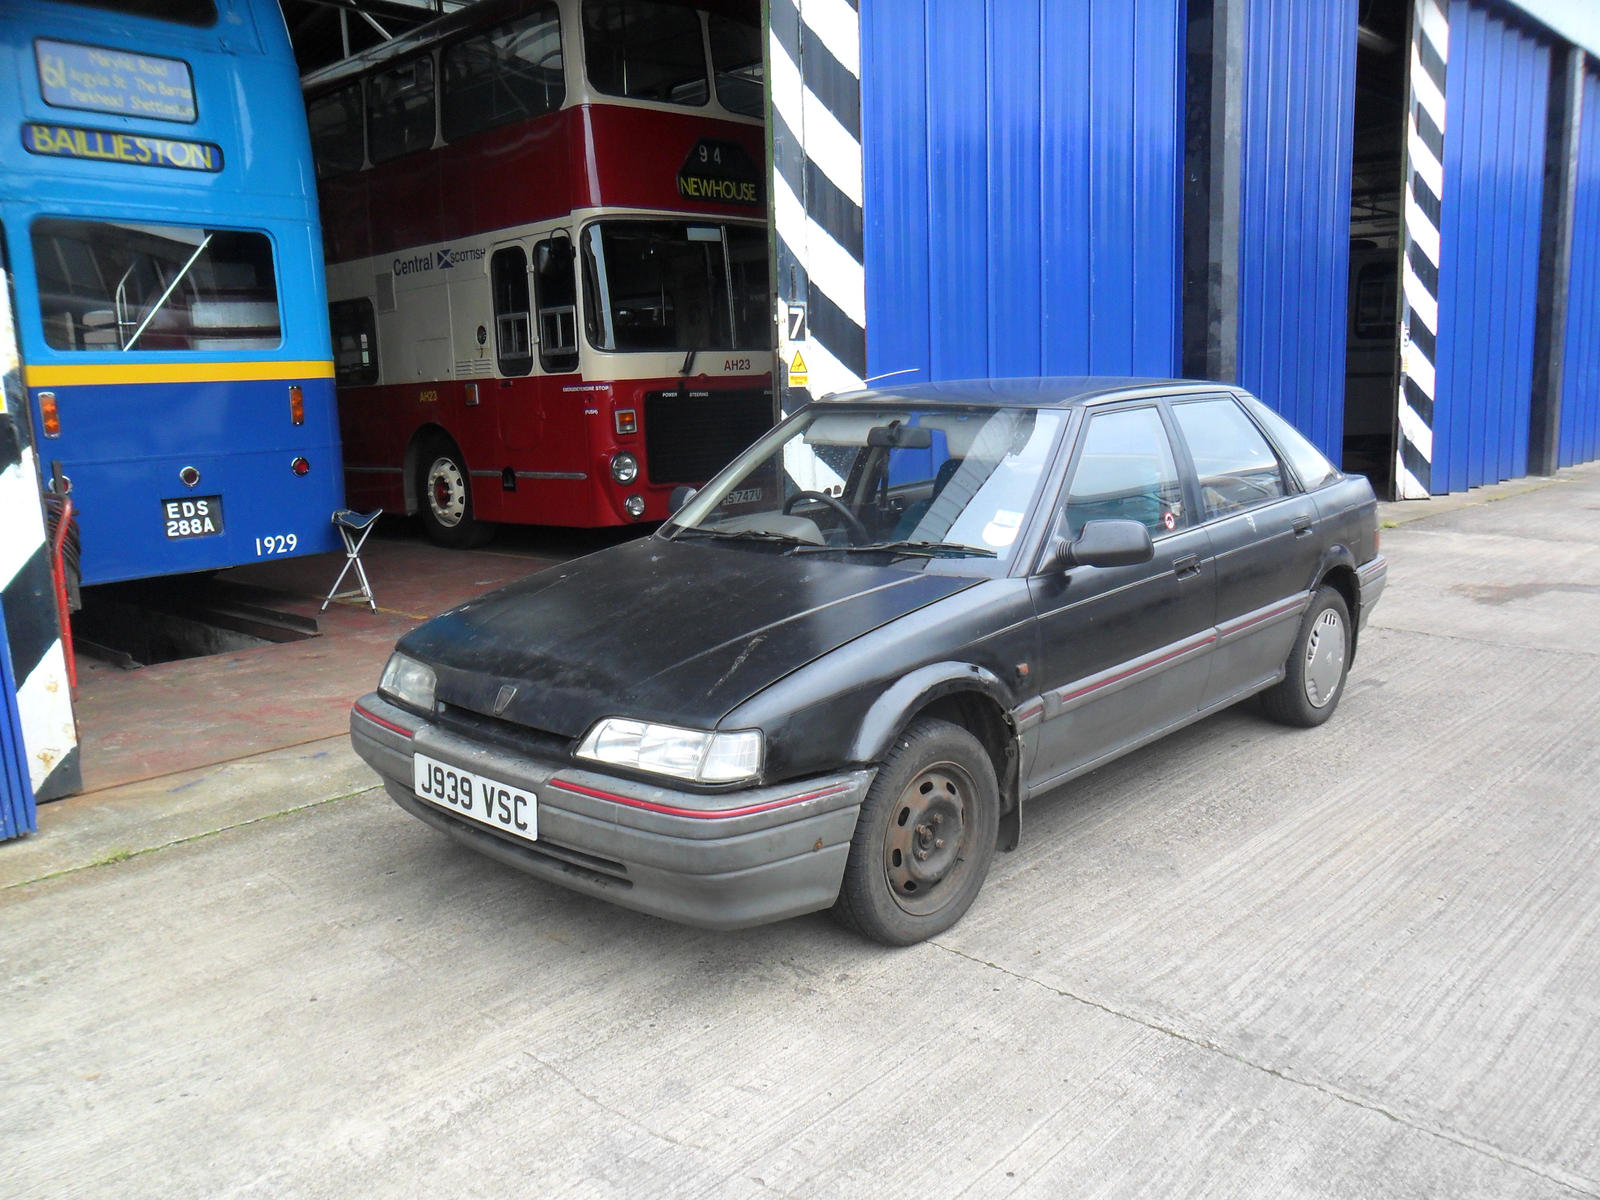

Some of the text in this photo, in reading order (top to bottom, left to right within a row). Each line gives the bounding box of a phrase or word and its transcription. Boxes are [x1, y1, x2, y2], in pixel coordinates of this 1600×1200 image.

[33, 126, 212, 169] BAILLIESTON
[679, 176, 757, 201] NEWHOUSE
[393, 248, 486, 276] Central SCOTTISH
[789, 307, 805, 340] 7
[723, 359, 752, 371] AH23
[166, 500, 209, 519] EDS
[166, 517, 215, 537] 288A
[255, 533, 298, 556] 1929
[421, 764, 528, 830] J939 VSC
